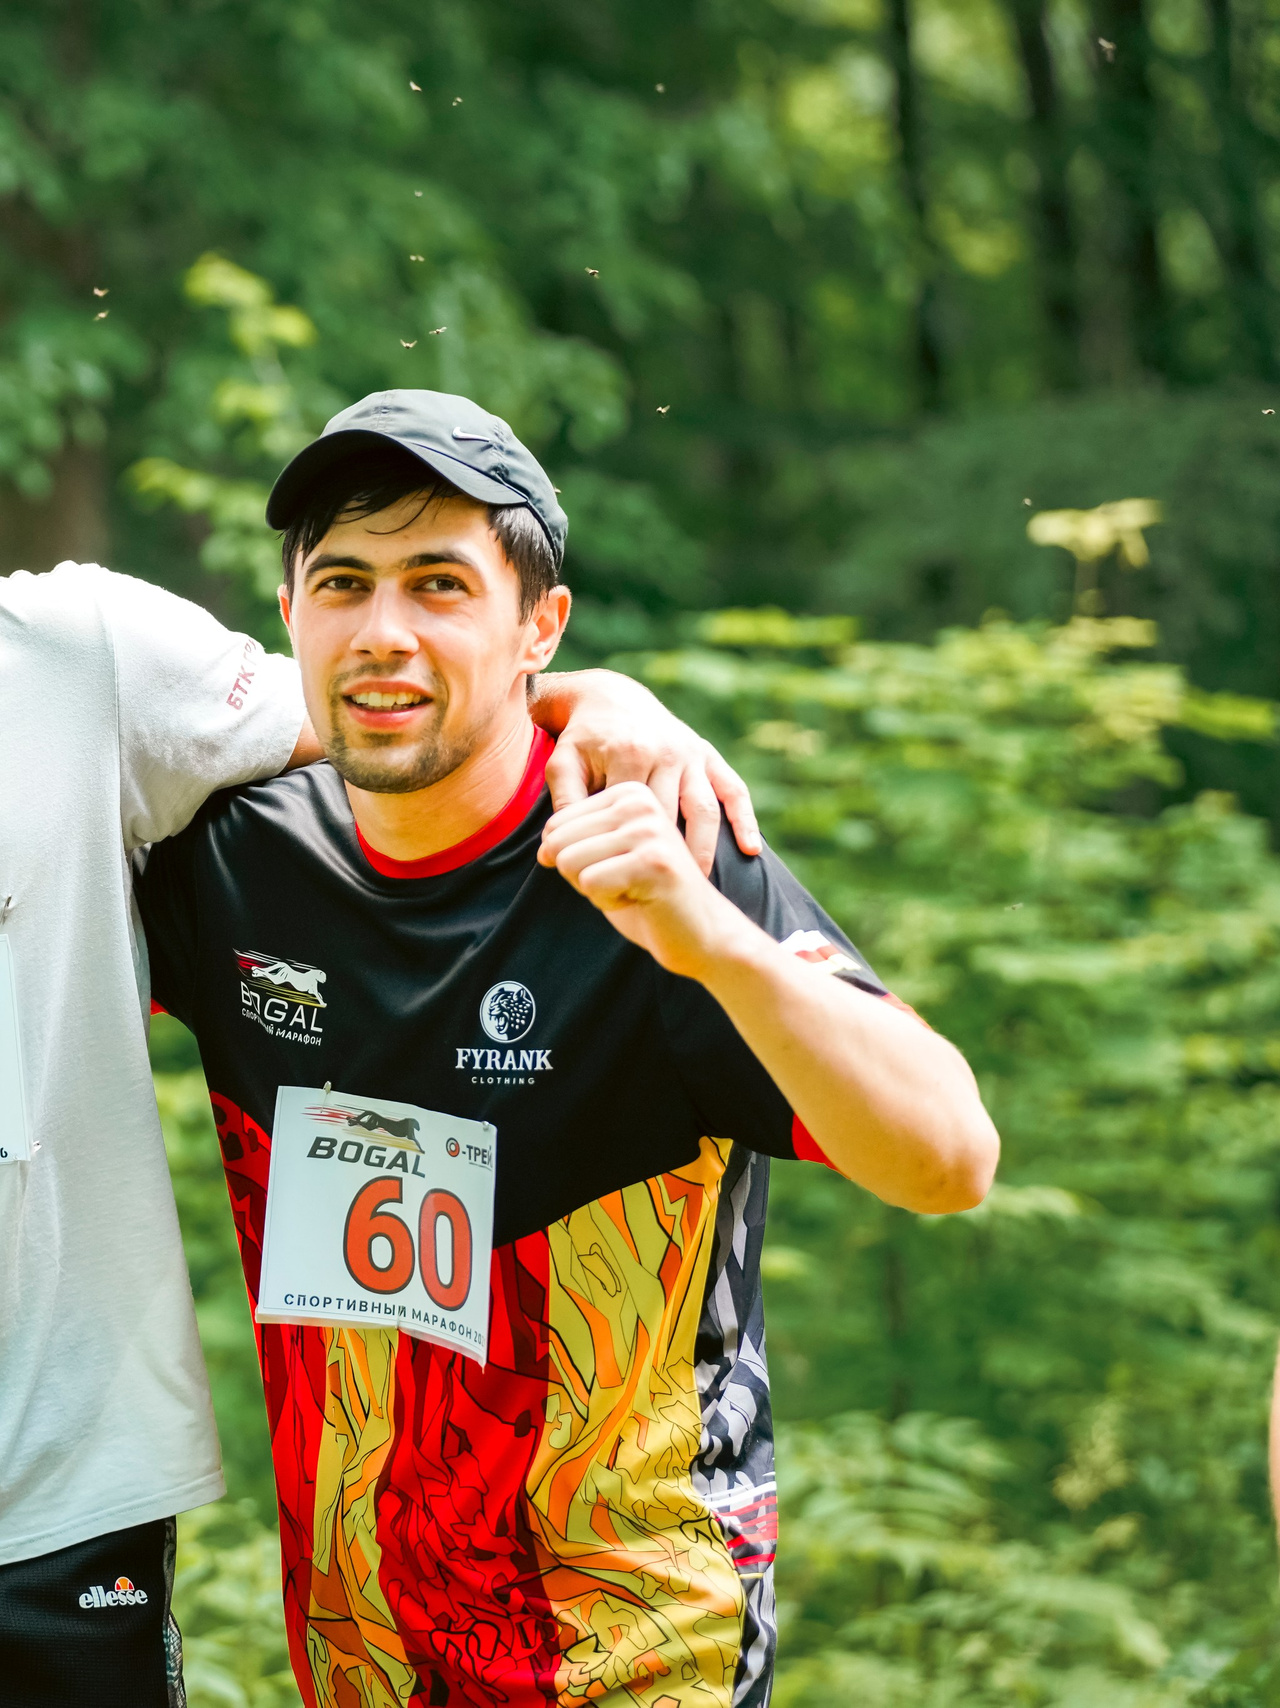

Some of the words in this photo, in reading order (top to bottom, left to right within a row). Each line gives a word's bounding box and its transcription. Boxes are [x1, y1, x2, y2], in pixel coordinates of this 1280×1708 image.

[226, 665, 255, 711] БТК
[275, 1028, 322, 1046] МАРАФОН
[455, 1048, 554, 1071] FYRANK
[471, 1076, 536, 1085] CLOTHING
[307, 1136, 426, 1178] BOGAL
[342, 1175, 473, 1311] 60
[284, 1293, 407, 1318] СПОРТИВНЫЙ
[412, 1308, 472, 1340] МАРАФОН
[79, 1585, 148, 1609] ellesse
